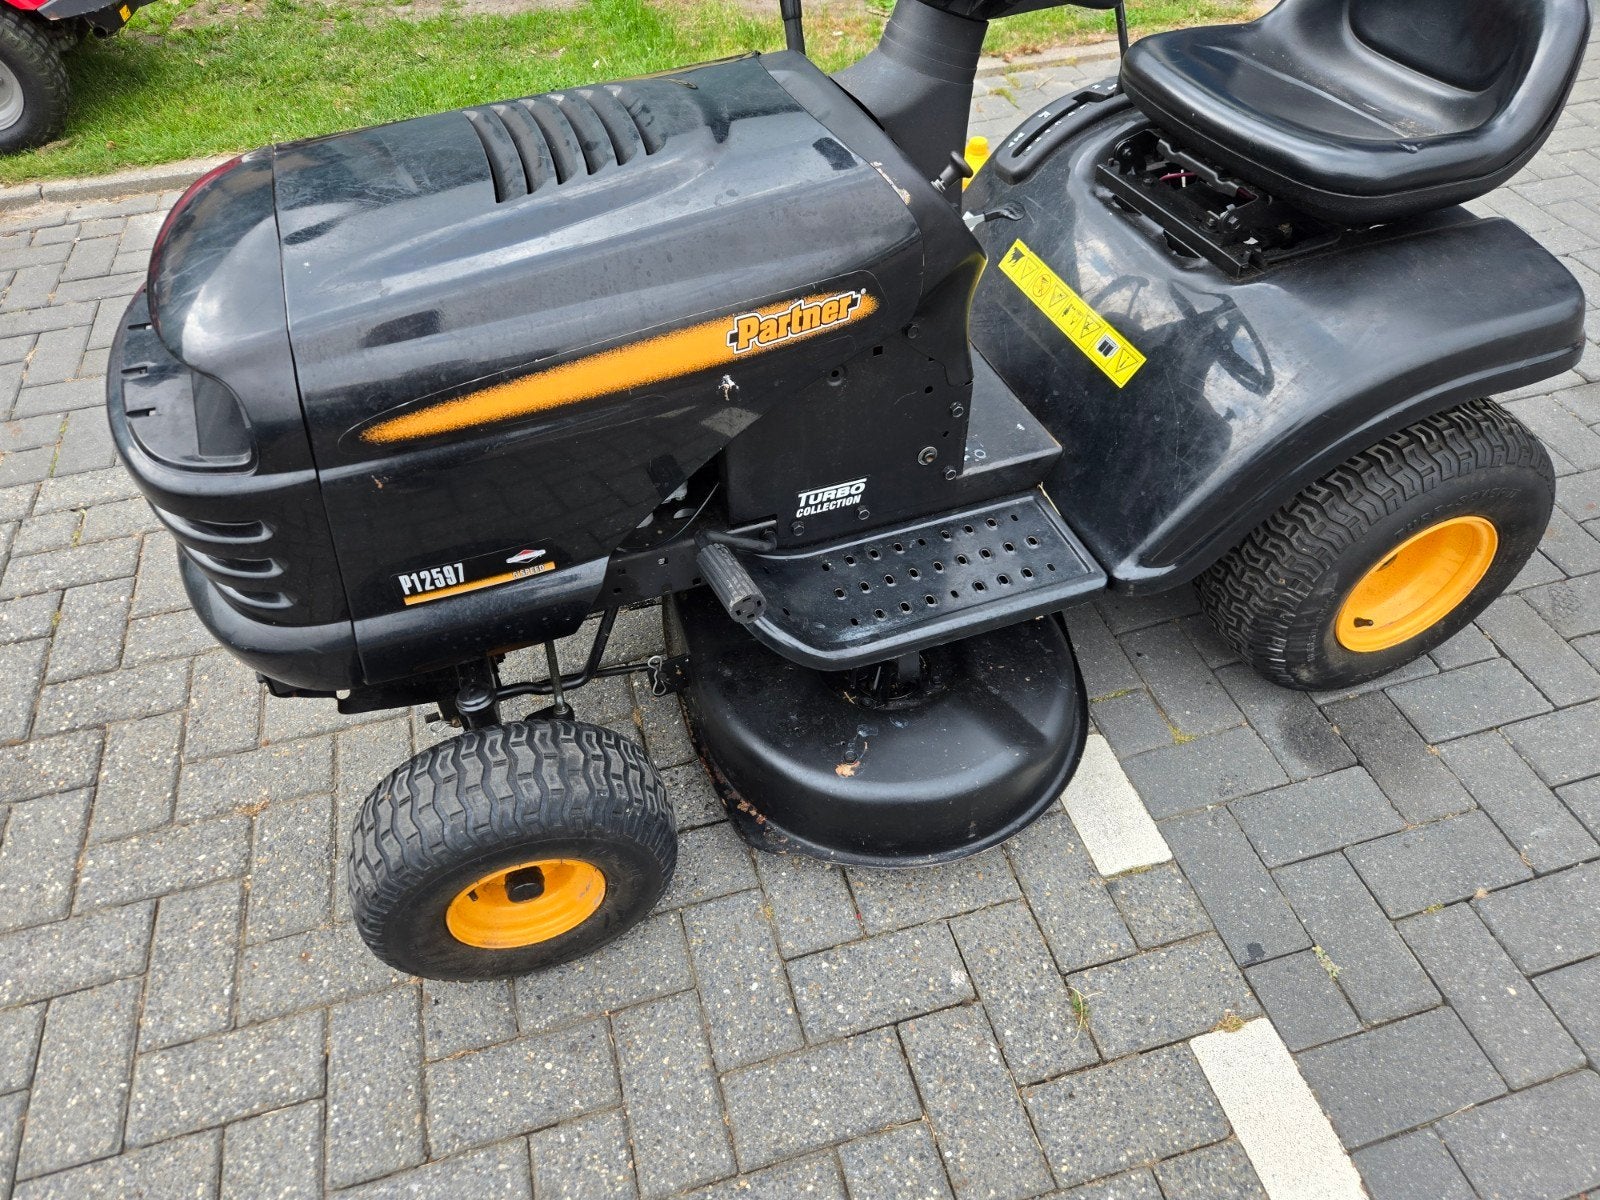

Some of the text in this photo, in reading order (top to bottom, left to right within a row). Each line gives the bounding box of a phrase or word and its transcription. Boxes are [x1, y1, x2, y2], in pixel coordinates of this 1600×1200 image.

[734, 292, 858, 352] Partner
[795, 494, 862, 519] COLLECTION
[797, 478, 868, 508] TURBO
[398, 562, 465, 596] P12597
